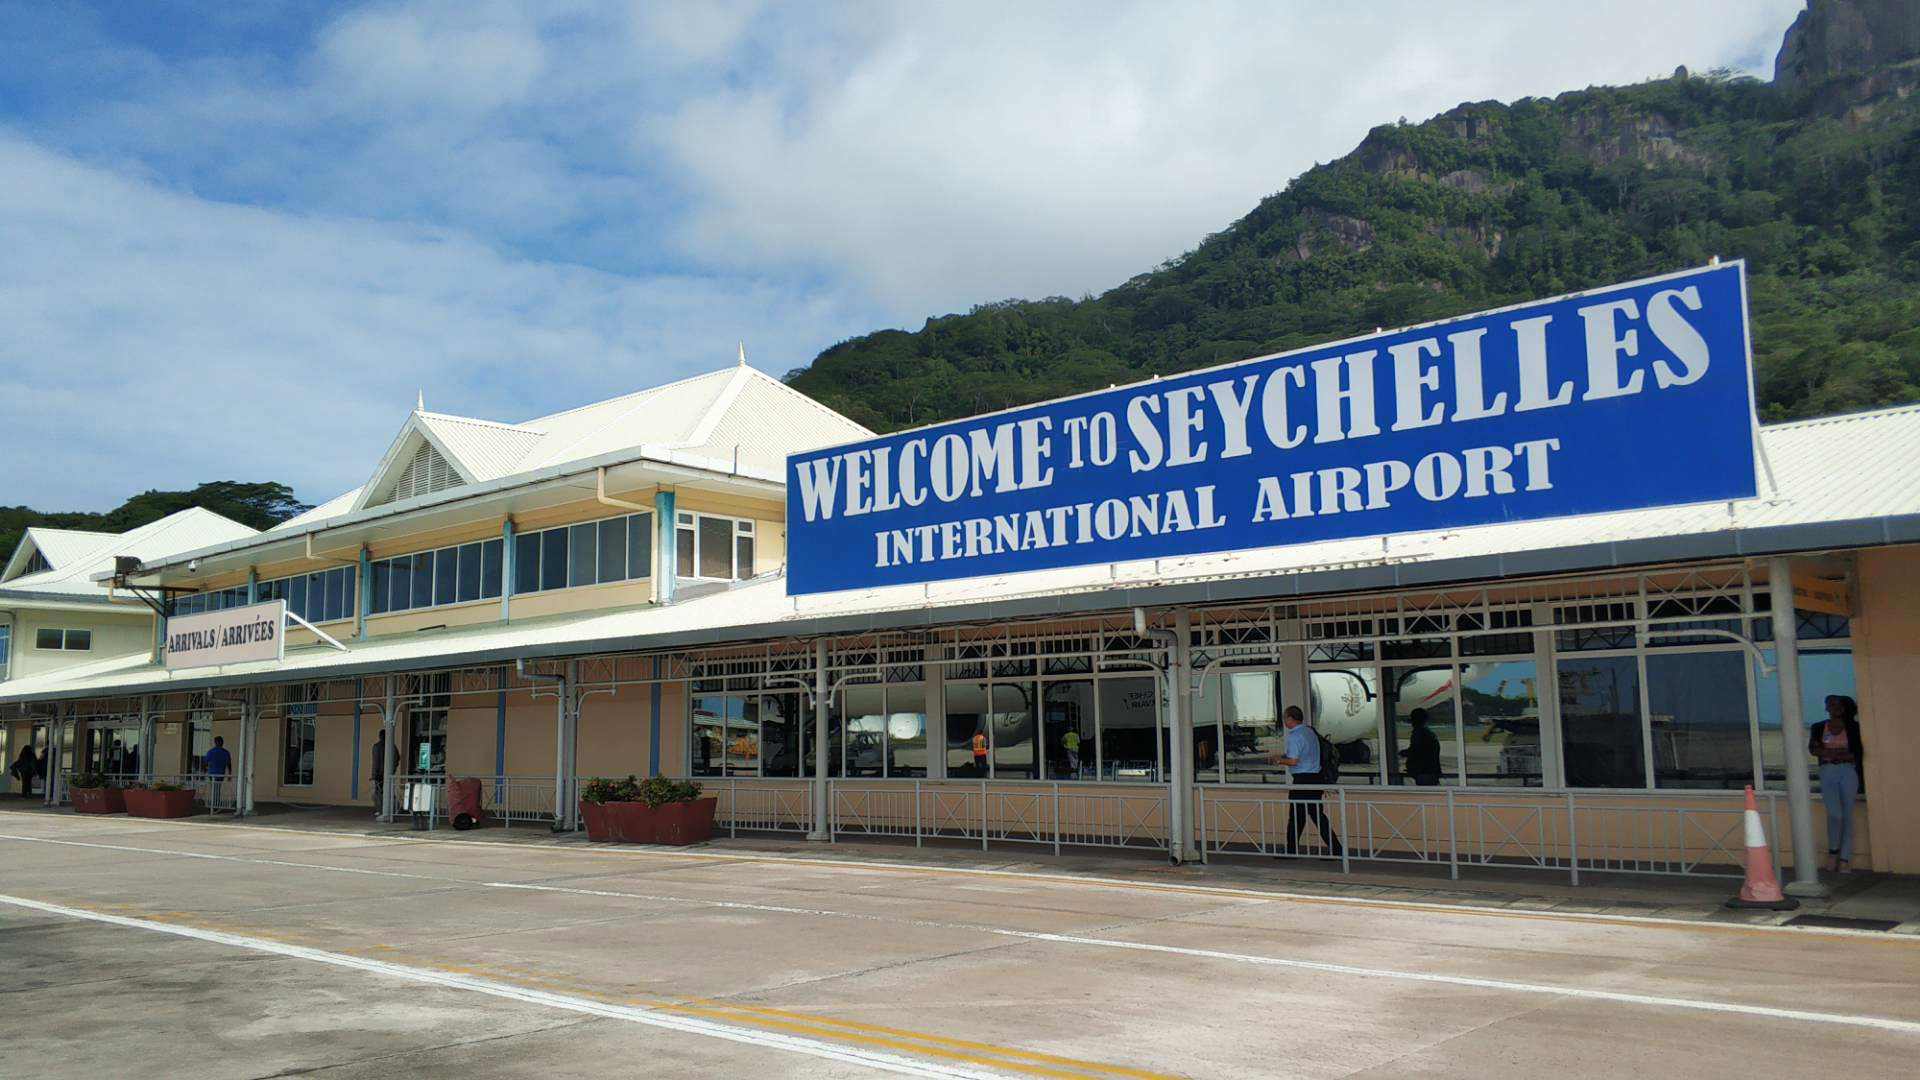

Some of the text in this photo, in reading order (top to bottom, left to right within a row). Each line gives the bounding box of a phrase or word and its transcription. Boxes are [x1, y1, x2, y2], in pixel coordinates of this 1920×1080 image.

[795, 285, 1710, 522] WELCOME TO SEYCHELLES
[875, 438, 1561, 568] INTERNATIONAL AIRPORT
